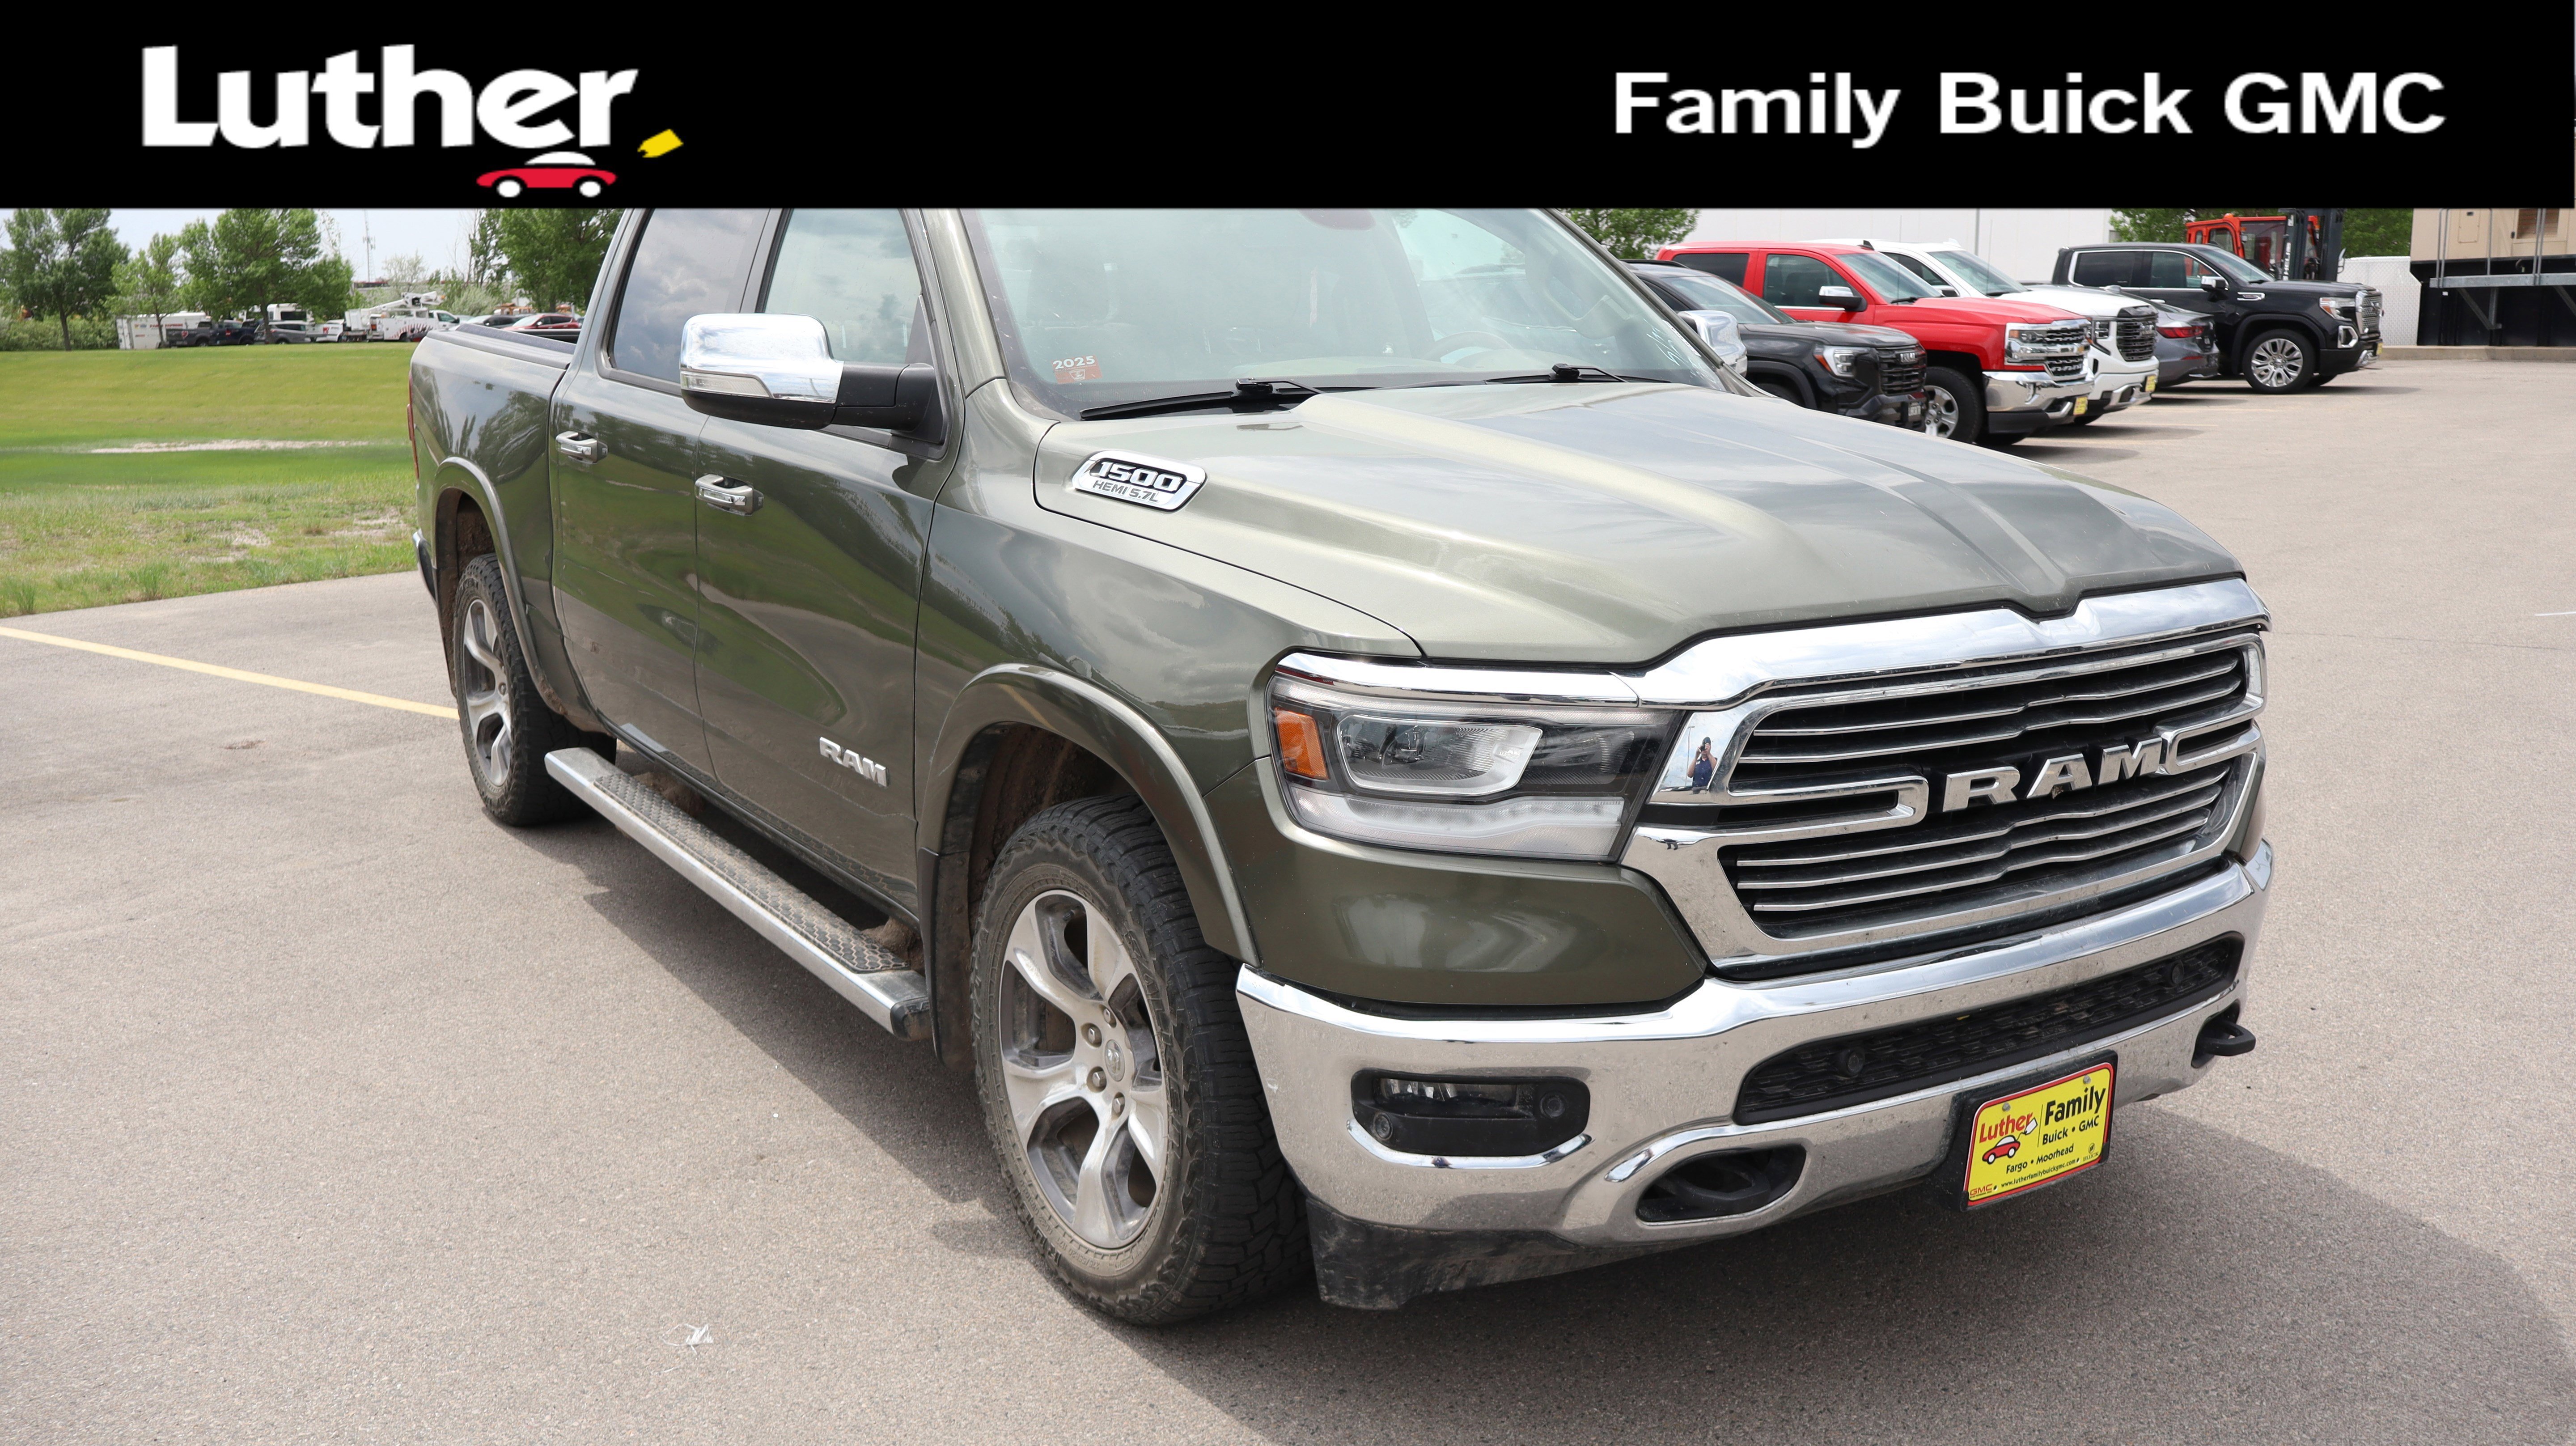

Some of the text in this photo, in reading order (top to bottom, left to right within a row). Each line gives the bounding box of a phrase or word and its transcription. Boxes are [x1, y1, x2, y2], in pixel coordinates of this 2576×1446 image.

[1052, 356, 1095, 369] 2025
[1092, 479, 1159, 503] HEMI 5.7L
[1097, 461, 1184, 492] 1500
[819, 736, 888, 788] RAM
[1942, 736, 2163, 813] RAM
[2044, 1085, 2106, 1126] Family
[1979, 1112, 2033, 1144] Luther
[2042, 1115, 2100, 1145] Buick GMC
[2000, 1158, 2076, 1188] www.lutherfamilybuickgmc.com
[2006, 1143, 2074, 1174] Fargo Moorhead
[1970, 1183, 1993, 1196] GMC
